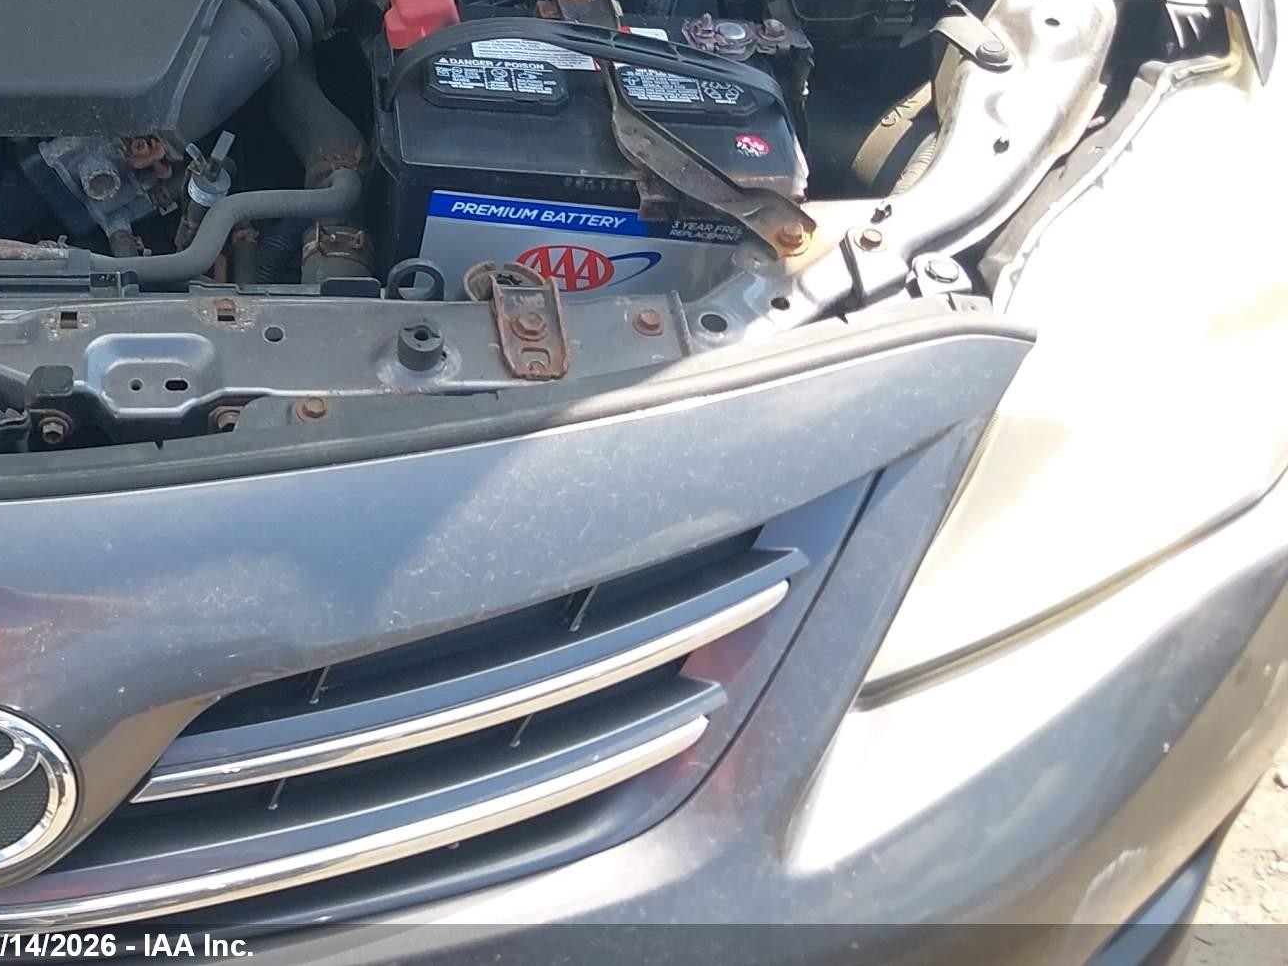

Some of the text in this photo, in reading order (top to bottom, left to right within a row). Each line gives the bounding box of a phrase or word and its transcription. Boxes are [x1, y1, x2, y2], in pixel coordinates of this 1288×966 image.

[449, 57, 494, 67] DANGER
[503, 61, 545, 70] POISON
[451, 201, 627, 229] PREMIUM BATTERY
[671, 220, 680, 229] 3
[682, 222, 714, 233] YEAR
[669, 229, 741, 242] REPLACEMENT
[518, 245, 611, 292] AAA
